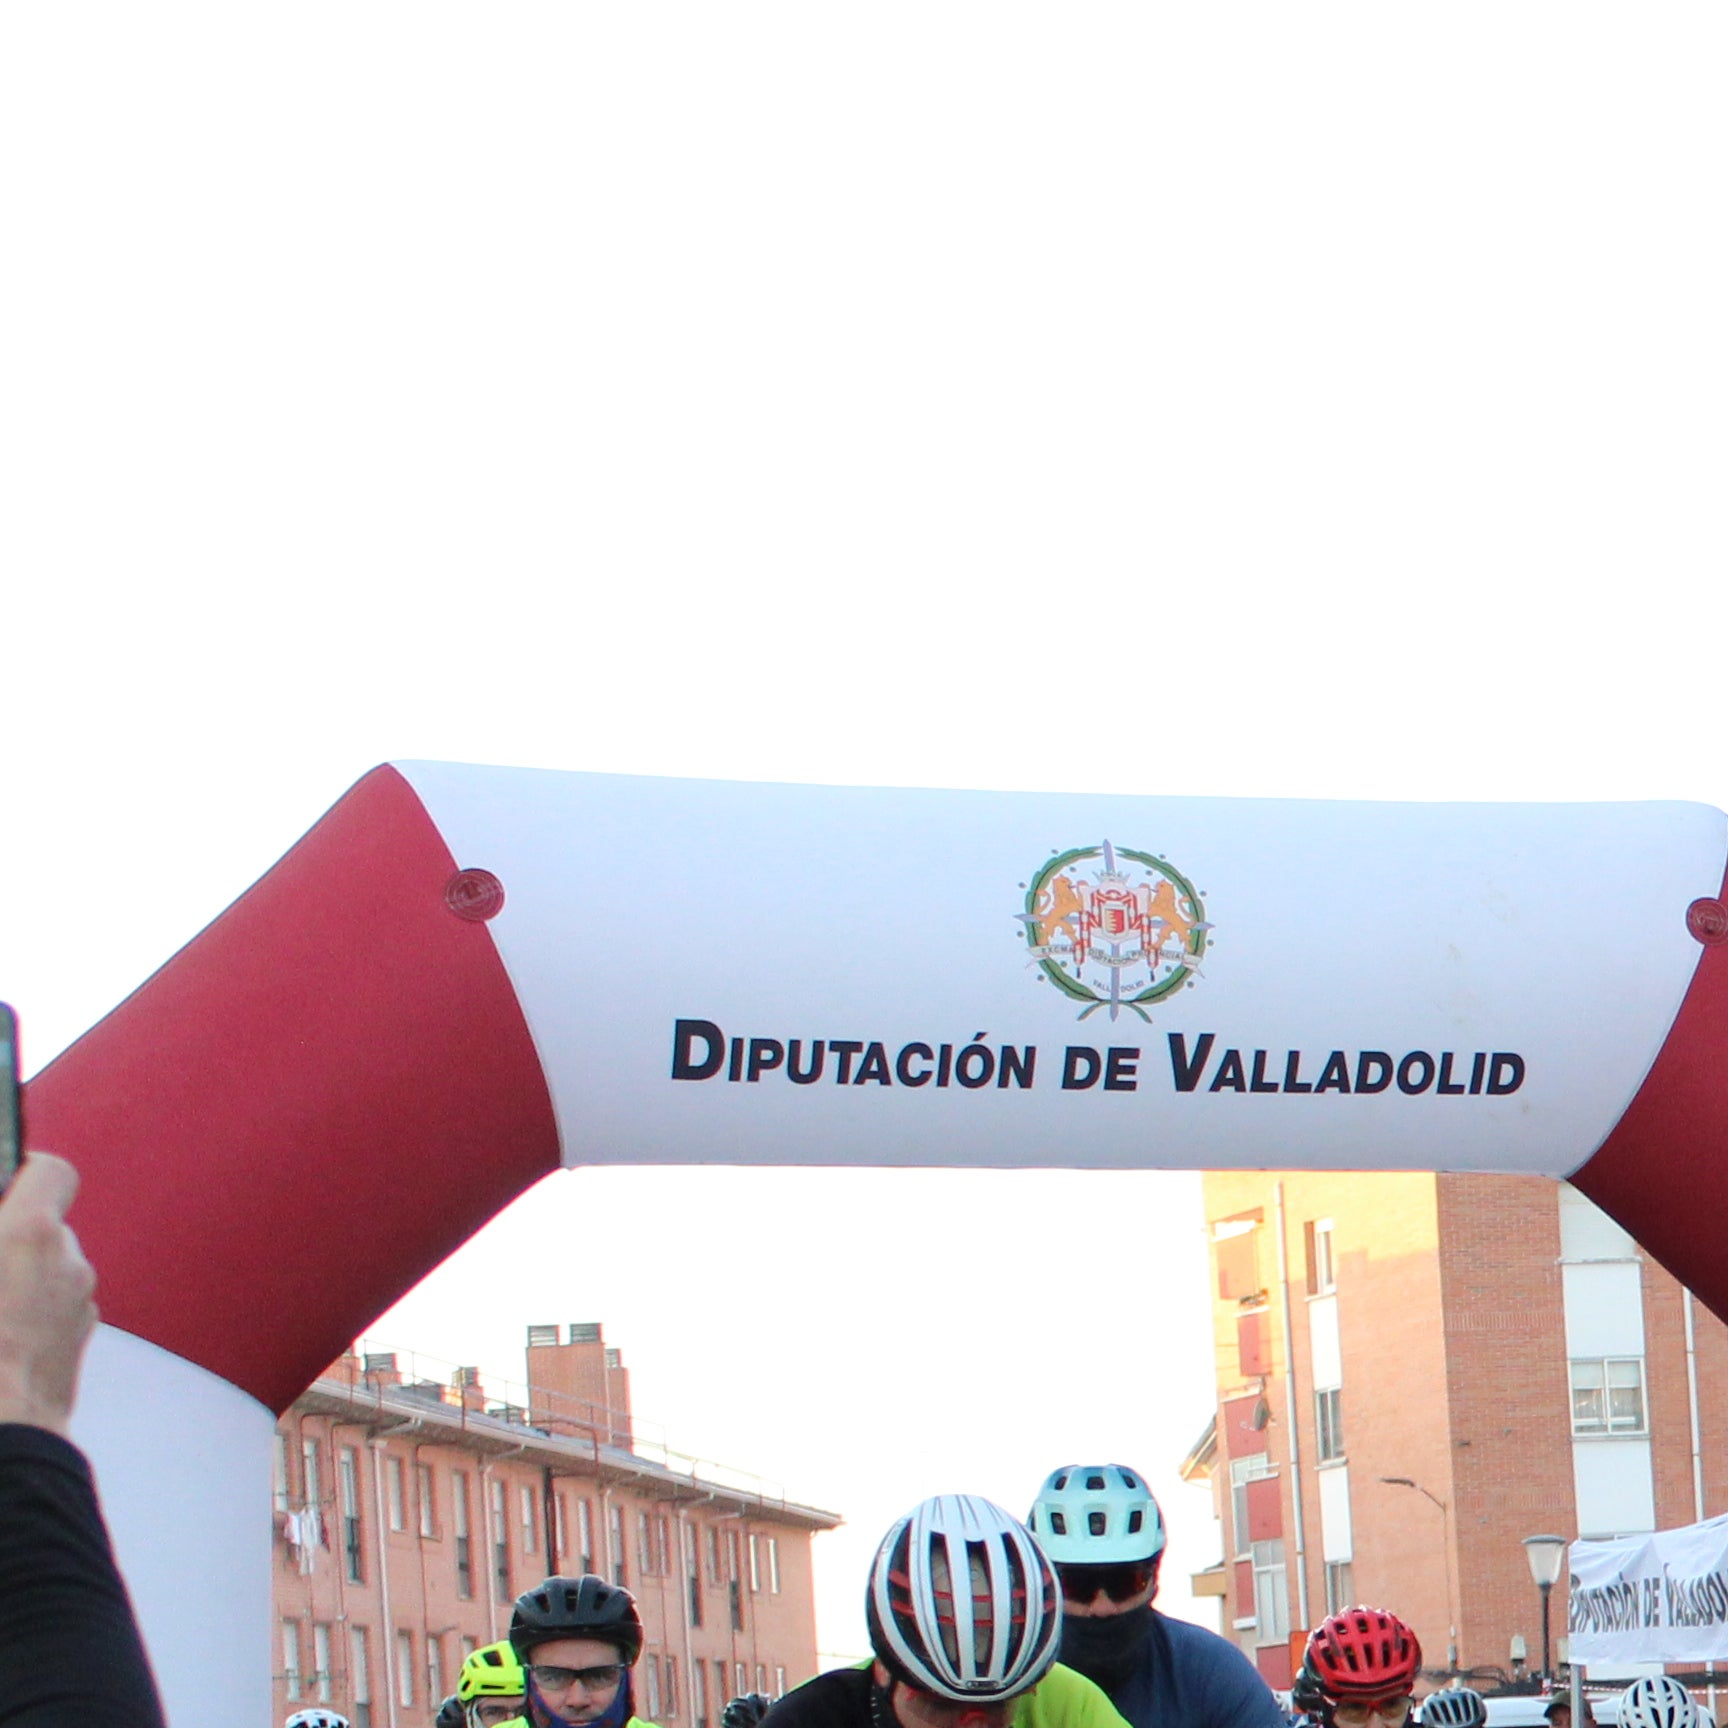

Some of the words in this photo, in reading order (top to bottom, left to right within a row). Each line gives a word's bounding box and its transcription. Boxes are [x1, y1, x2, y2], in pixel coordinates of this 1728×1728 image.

[670, 1018, 1036, 1090] DIPUTACIÓN
[1062, 1045, 1139, 1092] DE
[1167, 1031, 1526, 1097] VALLADOLID
[1643, 1577, 1661, 1628] DE
